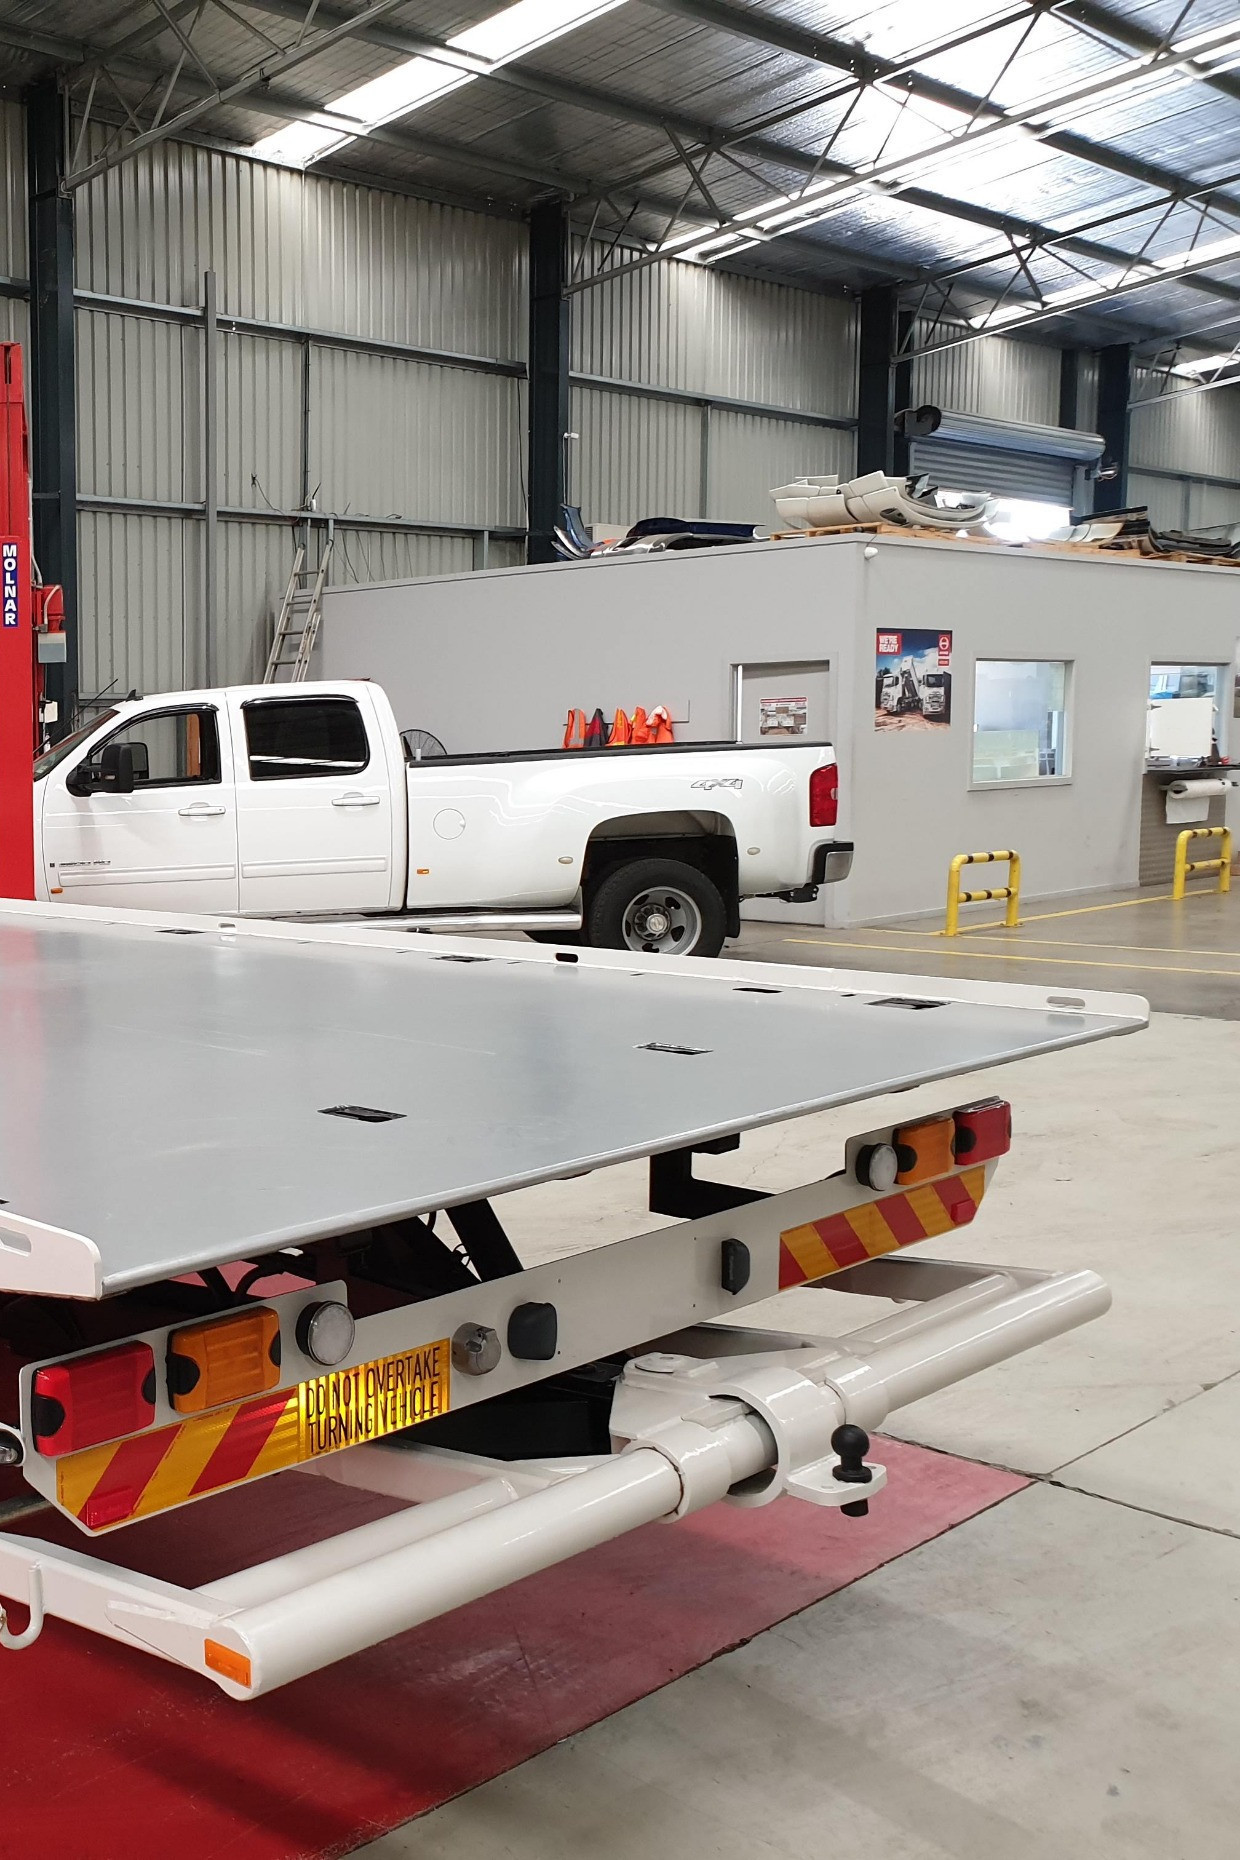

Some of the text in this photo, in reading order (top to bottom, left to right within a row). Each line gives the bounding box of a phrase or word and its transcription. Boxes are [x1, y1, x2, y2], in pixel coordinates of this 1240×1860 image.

[2, 544, 17, 625] MOLNAR
[879, 643, 899, 653] READY
[306, 1346, 440, 1418] DO NOT OVERTAKE
[307, 1380, 439, 1453] TURNING VEHICLE
